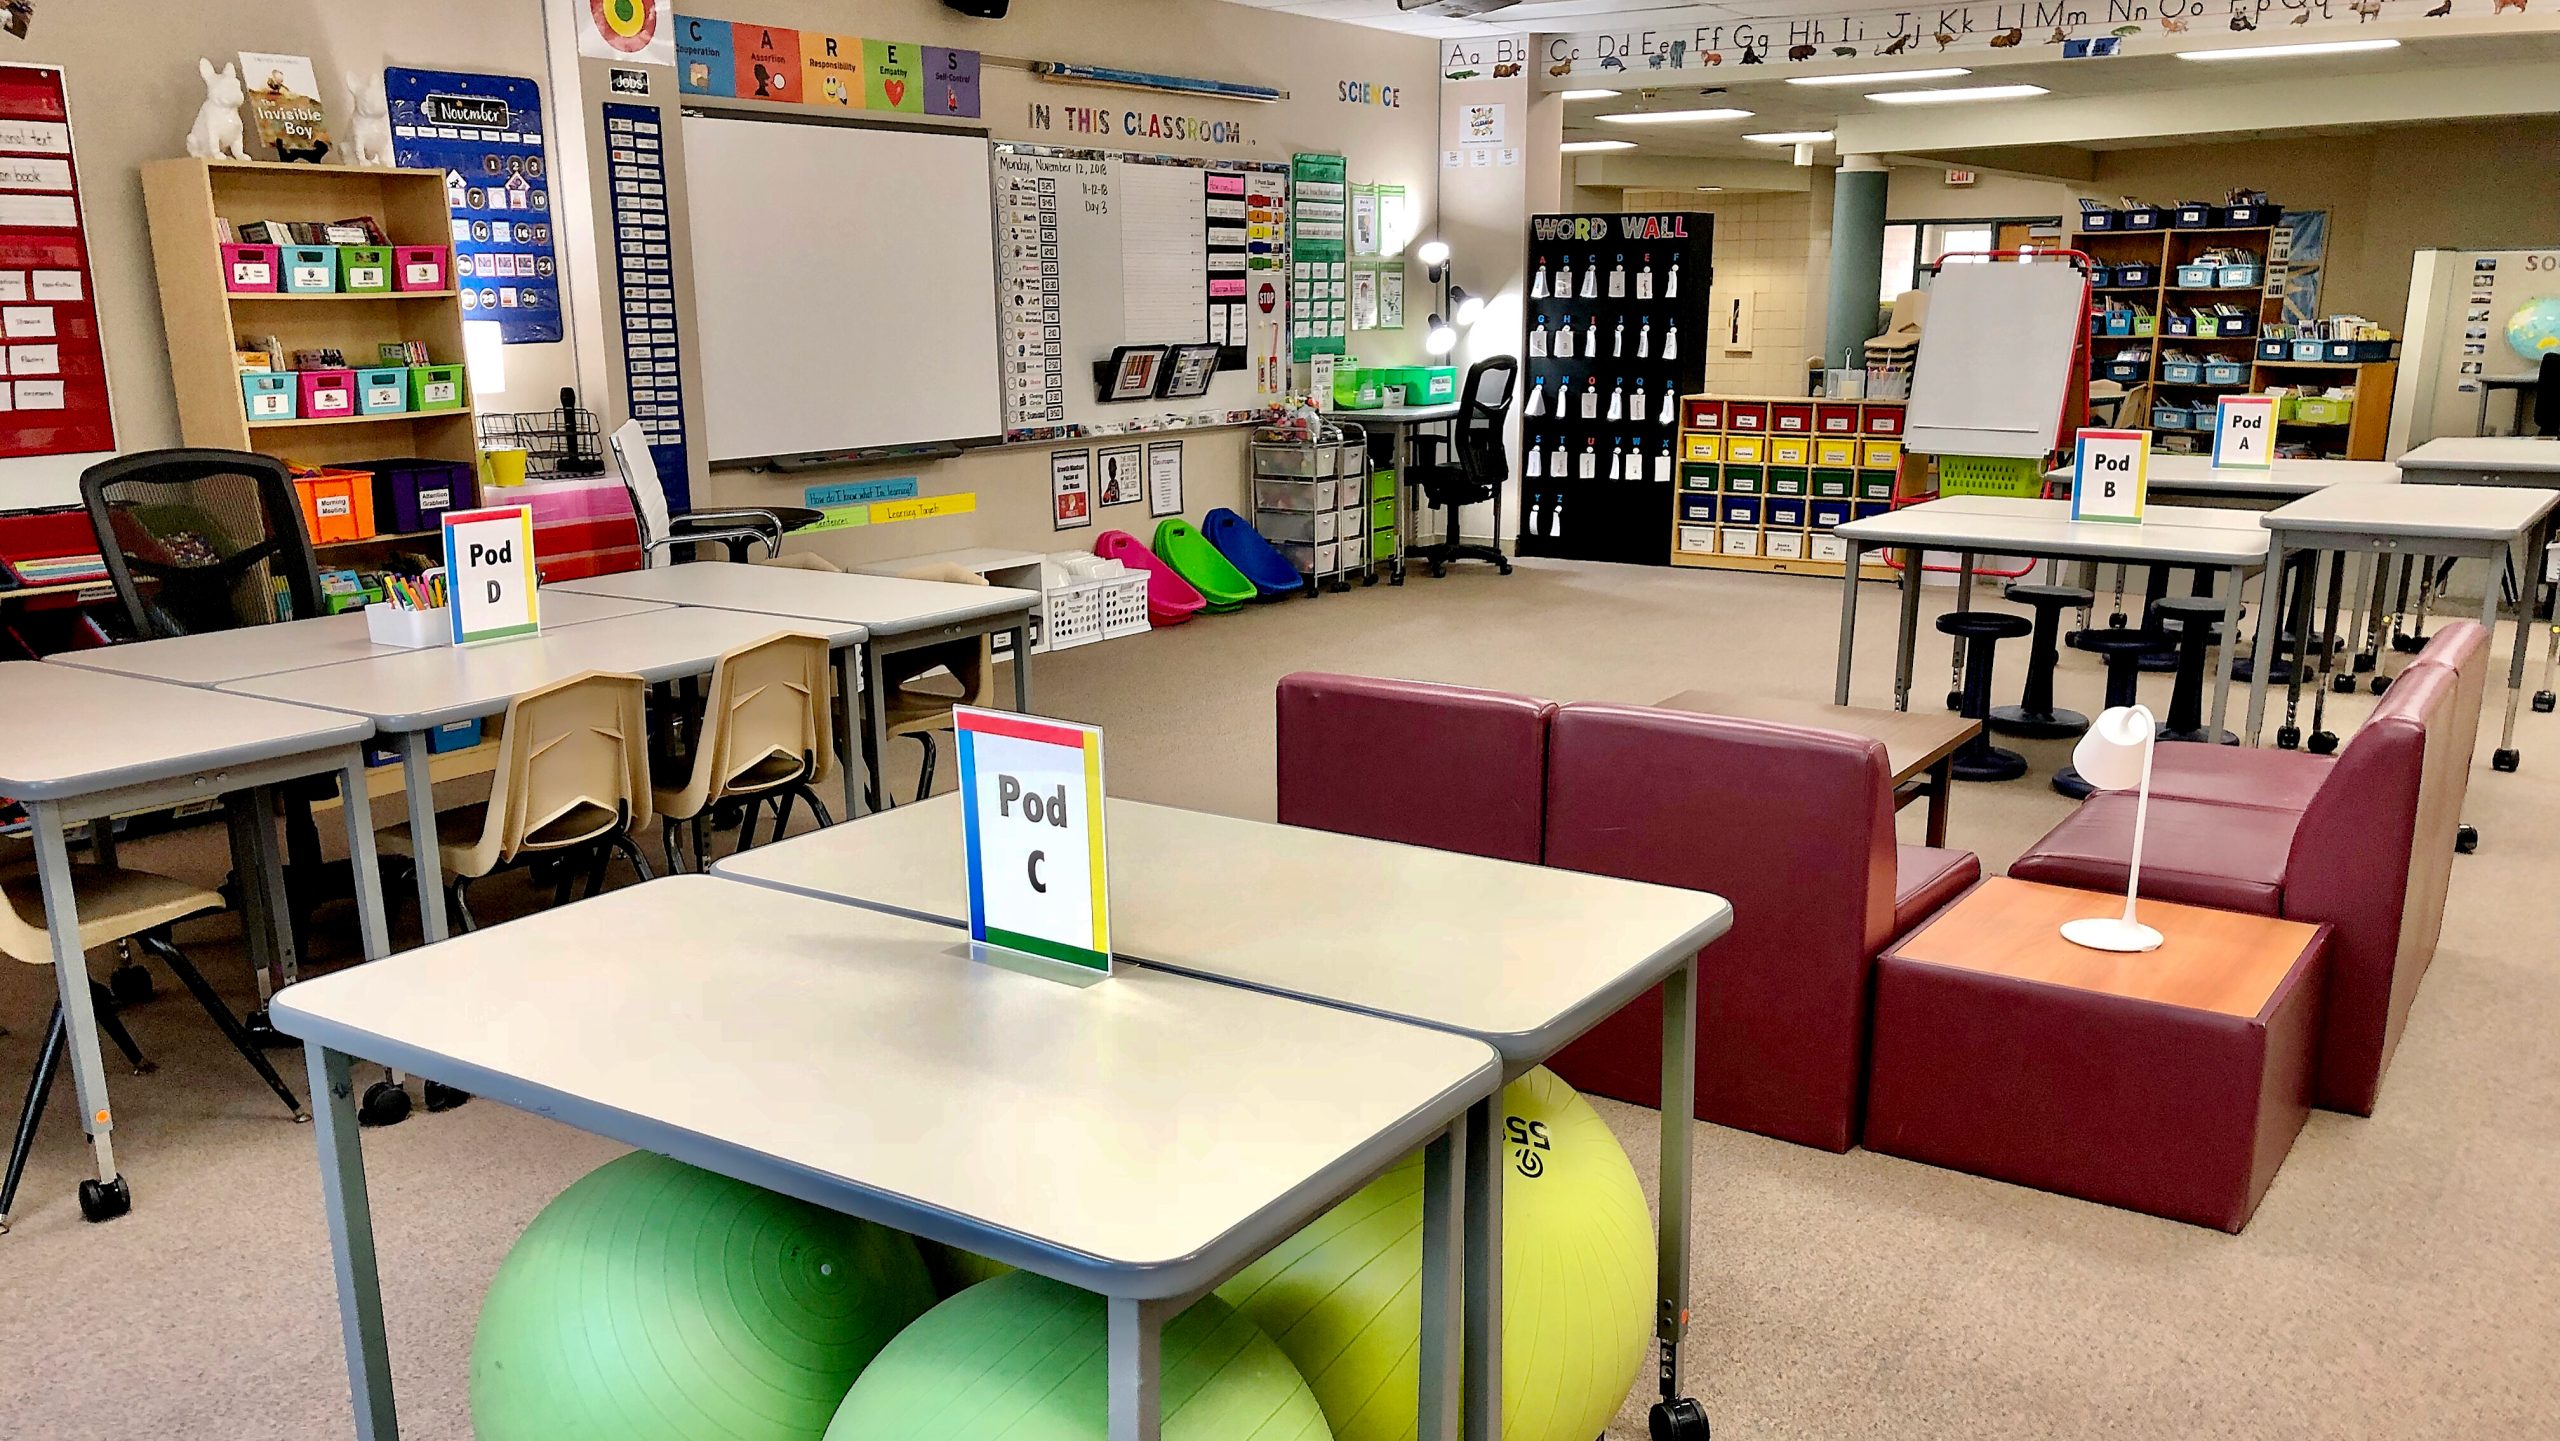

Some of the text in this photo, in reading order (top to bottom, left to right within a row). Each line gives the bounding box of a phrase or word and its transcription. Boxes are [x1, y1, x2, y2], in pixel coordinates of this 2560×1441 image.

[689, 21, 702, 41] C
[761, 30, 774, 50] A
[825, 37, 838, 57] R
[751, 53, 786, 64] Assertion
[887, 45, 898, 64] E
[947, 52, 958, 70] S
[809, 58, 856, 73] Responsibility
[879, 65, 908, 78] Empathy
[616, 74, 644, 90] Jobs
[935, 72, 970, 83] Self-Control
[1338, 80, 1400, 108] SCIENCE
[257, 107, 322, 122] Invisible
[440, 102, 500, 122] November
[1027, 102, 1050, 130] IN
[1064, 106, 1110, 135] THIS
[30, 129, 52, 146] text
[284, 122, 313, 140] Boy
[489, 160, 496, 170] 1
[512, 161, 520, 170] 2
[530, 161, 538, 170] 3
[1000, 156, 1033, 174] Monday,
[1035, 158, 1072, 173] November
[1090, 163, 1107, 175] 2018
[13, 165, 41, 182] book
[1082, 182, 1108, 196] 11-12-18
[473, 193, 480, 203] 7
[533, 195, 545, 205] 10
[1085, 200, 1108, 215] Day 3
[475, 227, 487, 237] 14
[517, 228, 528, 238] 16
[536, 228, 547, 238] 17
[1534, 216, 1689, 241] WORD WALL
[1539, 253, 1680, 264] A B C D E F
[2525, 255, 2560, 272] SO
[539, 261, 551, 271] 24
[523, 294, 536, 303] 30
[1028, 297, 1040, 305] Art
[1259, 292, 1274, 304] STOP
[1537, 314, 1675, 326] G H I J K L
[1536, 376, 1544, 384] M
[1562, 376, 1569, 384] N
[1616, 377, 1623, 385] P
[1636, 377, 1644, 386] Q
[1666, 380, 1673, 388] R
[2232, 415, 2262, 429] Pod
[1535, 435, 1670, 448] S T U V W X
[2239, 436, 2250, 450] A
[2094, 453, 2130, 471] Pod
[810, 492, 825, 505] How
[826, 491, 835, 503] do
[842, 490, 857, 501] know
[859, 487, 873, 499] what
[2104, 481, 2116, 498] B
[321, 498, 347, 508] Morning
[422, 499, 449, 507] Grabbers
[1535, 494, 1563, 503] Y Z
[322, 506, 347, 515] Meeting
[887, 507, 916, 519] Learning
[470, 539, 512, 567] Pod
[486, 579, 502, 604] D
[998, 773, 1068, 828] Pod
[1027, 849, 1047, 893] C
